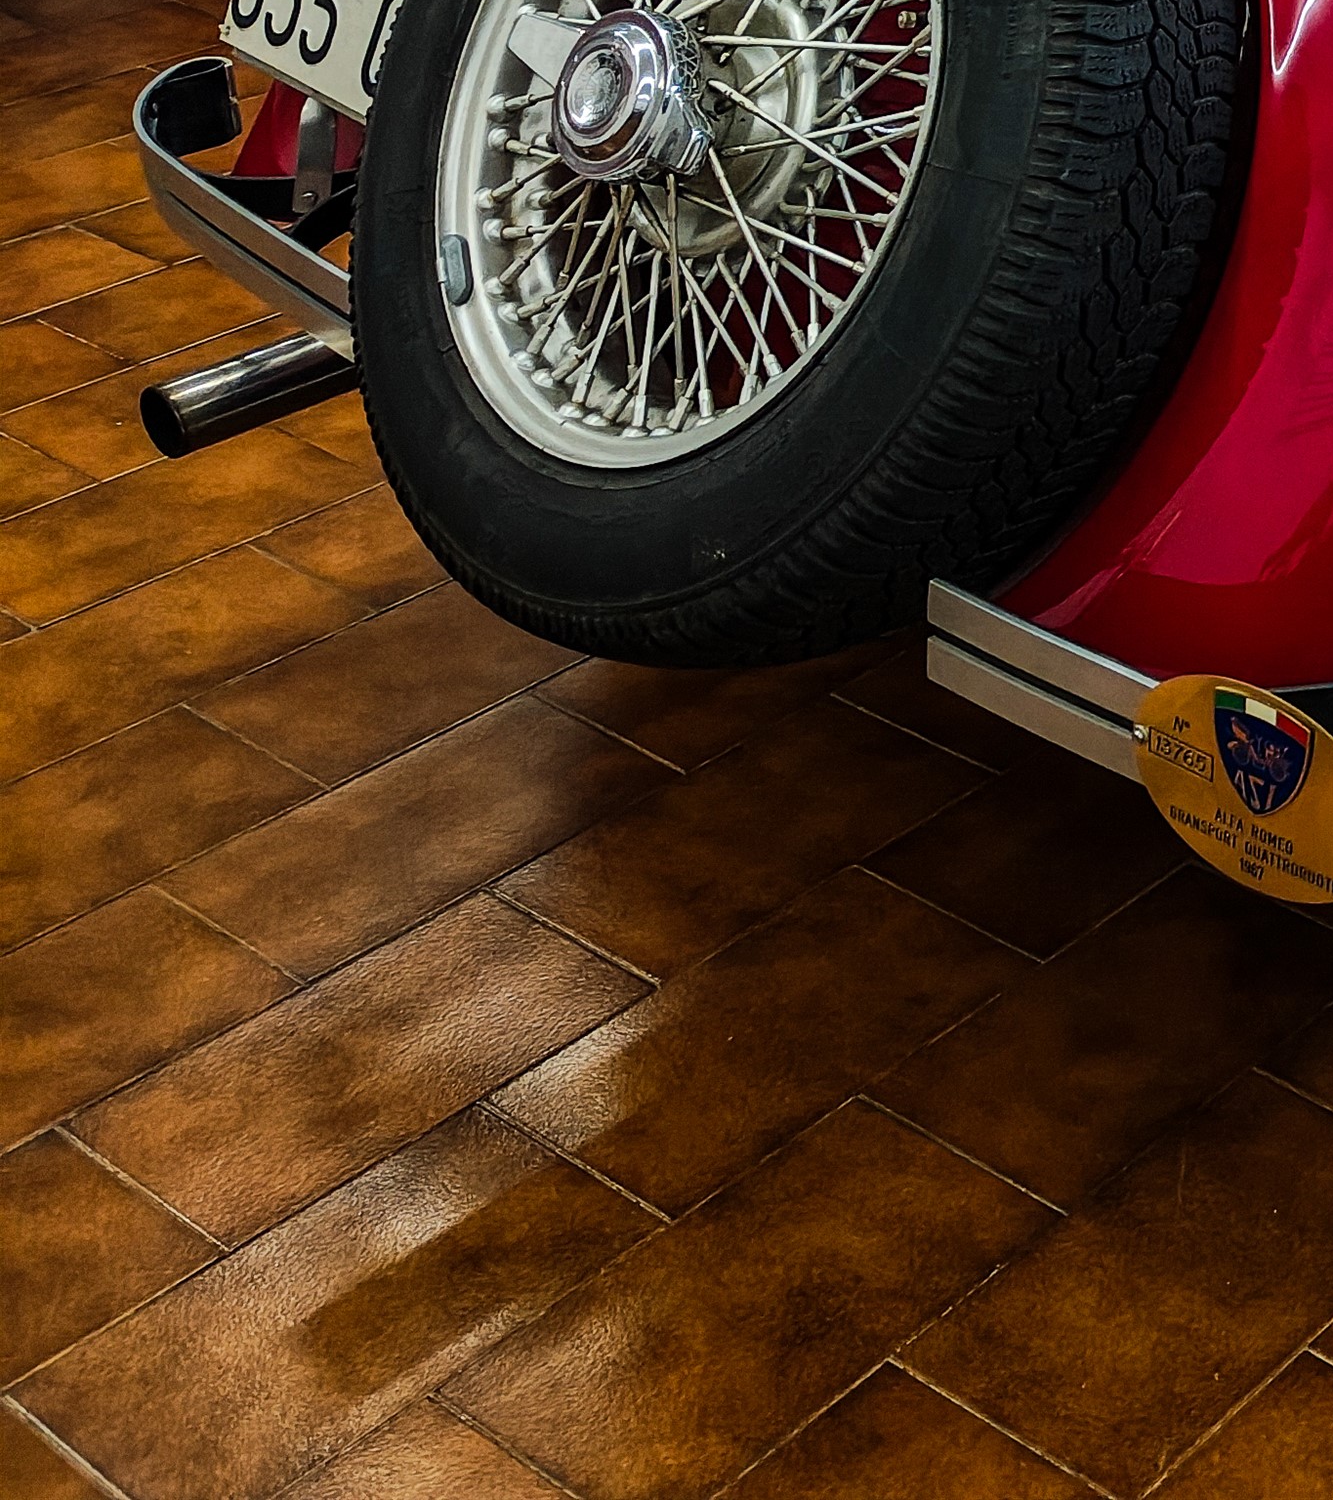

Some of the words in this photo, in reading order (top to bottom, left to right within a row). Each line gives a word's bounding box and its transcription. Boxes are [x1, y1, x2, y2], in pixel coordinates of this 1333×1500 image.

[1155, 735, 1207, 773] 13765
[1214, 807, 1244, 833] ALFA
[1250, 823, 1295, 856] ROMEO
